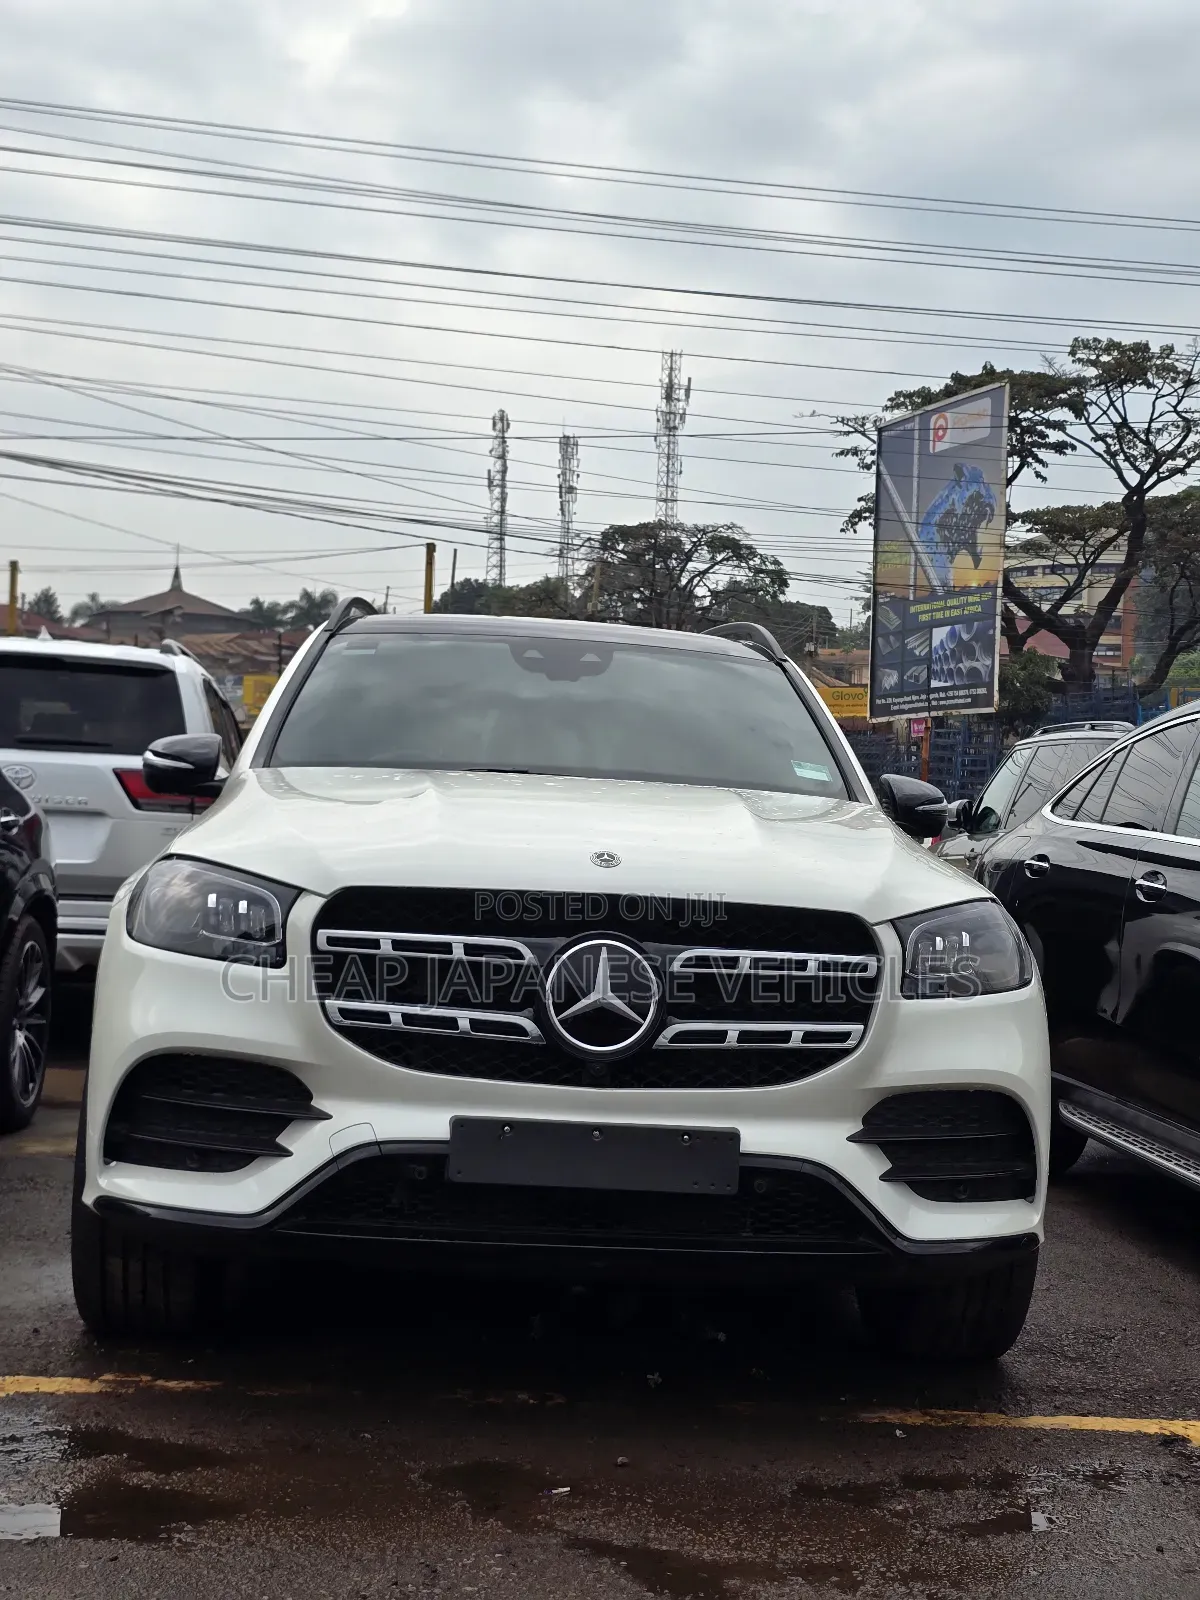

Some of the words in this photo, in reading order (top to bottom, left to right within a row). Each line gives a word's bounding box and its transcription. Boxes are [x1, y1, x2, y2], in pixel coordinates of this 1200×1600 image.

[946, 595, 968, 607] QUALITY
[918, 612, 932, 622] FIRST
[932, 609, 944, 620] TIME
[944, 608, 951, 618] IN
[950, 606, 963, 617] EAST
[963, 604, 982, 615] AFRICA
[831, 690, 865, 701] Glovo
